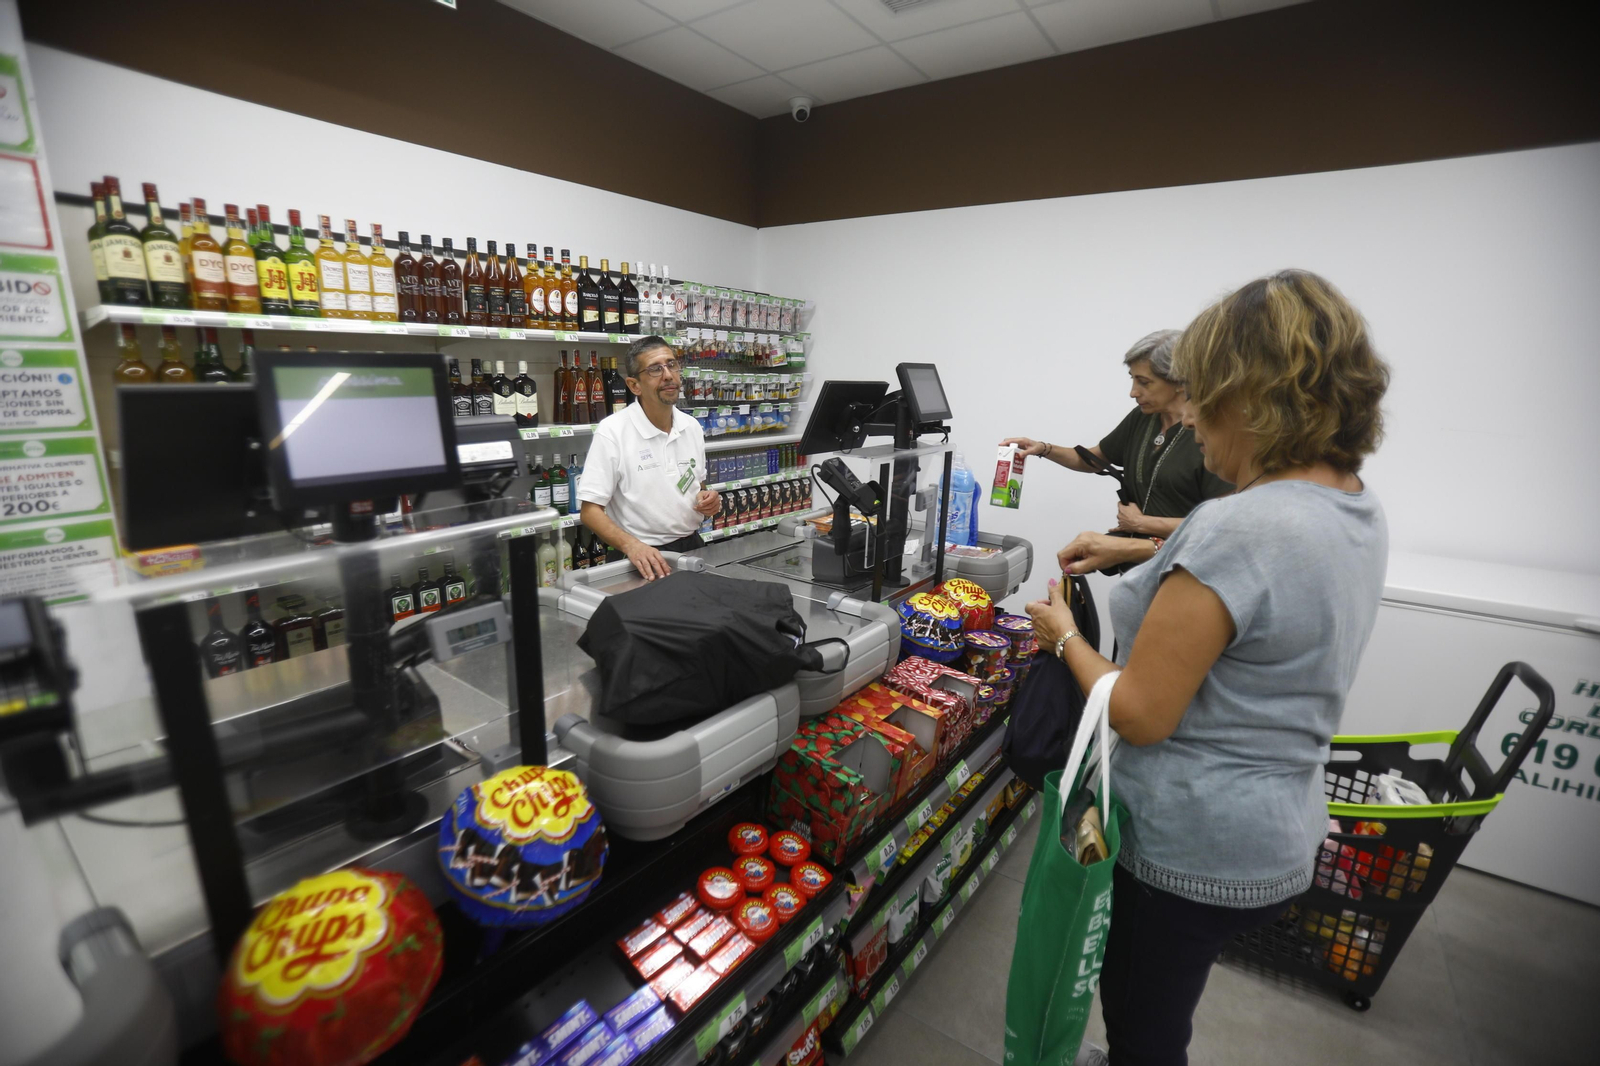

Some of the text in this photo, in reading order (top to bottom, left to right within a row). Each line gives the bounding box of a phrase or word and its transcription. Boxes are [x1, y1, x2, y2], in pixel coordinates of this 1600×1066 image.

[199, 258, 223, 269] DYC
[230, 262, 254, 273] DYC
[264, 269, 287, 290] J&B
[295, 272, 318, 292] J&B
[3, 410, 19, 418] DE
[17, 470, 75, 482] ADMITEN
[24, 480, 72, 491] IGUALES
[49, 549, 98, 563] CLIENTES
[256, 886, 372, 932] Chupa
[245, 913, 366, 982] Chups
